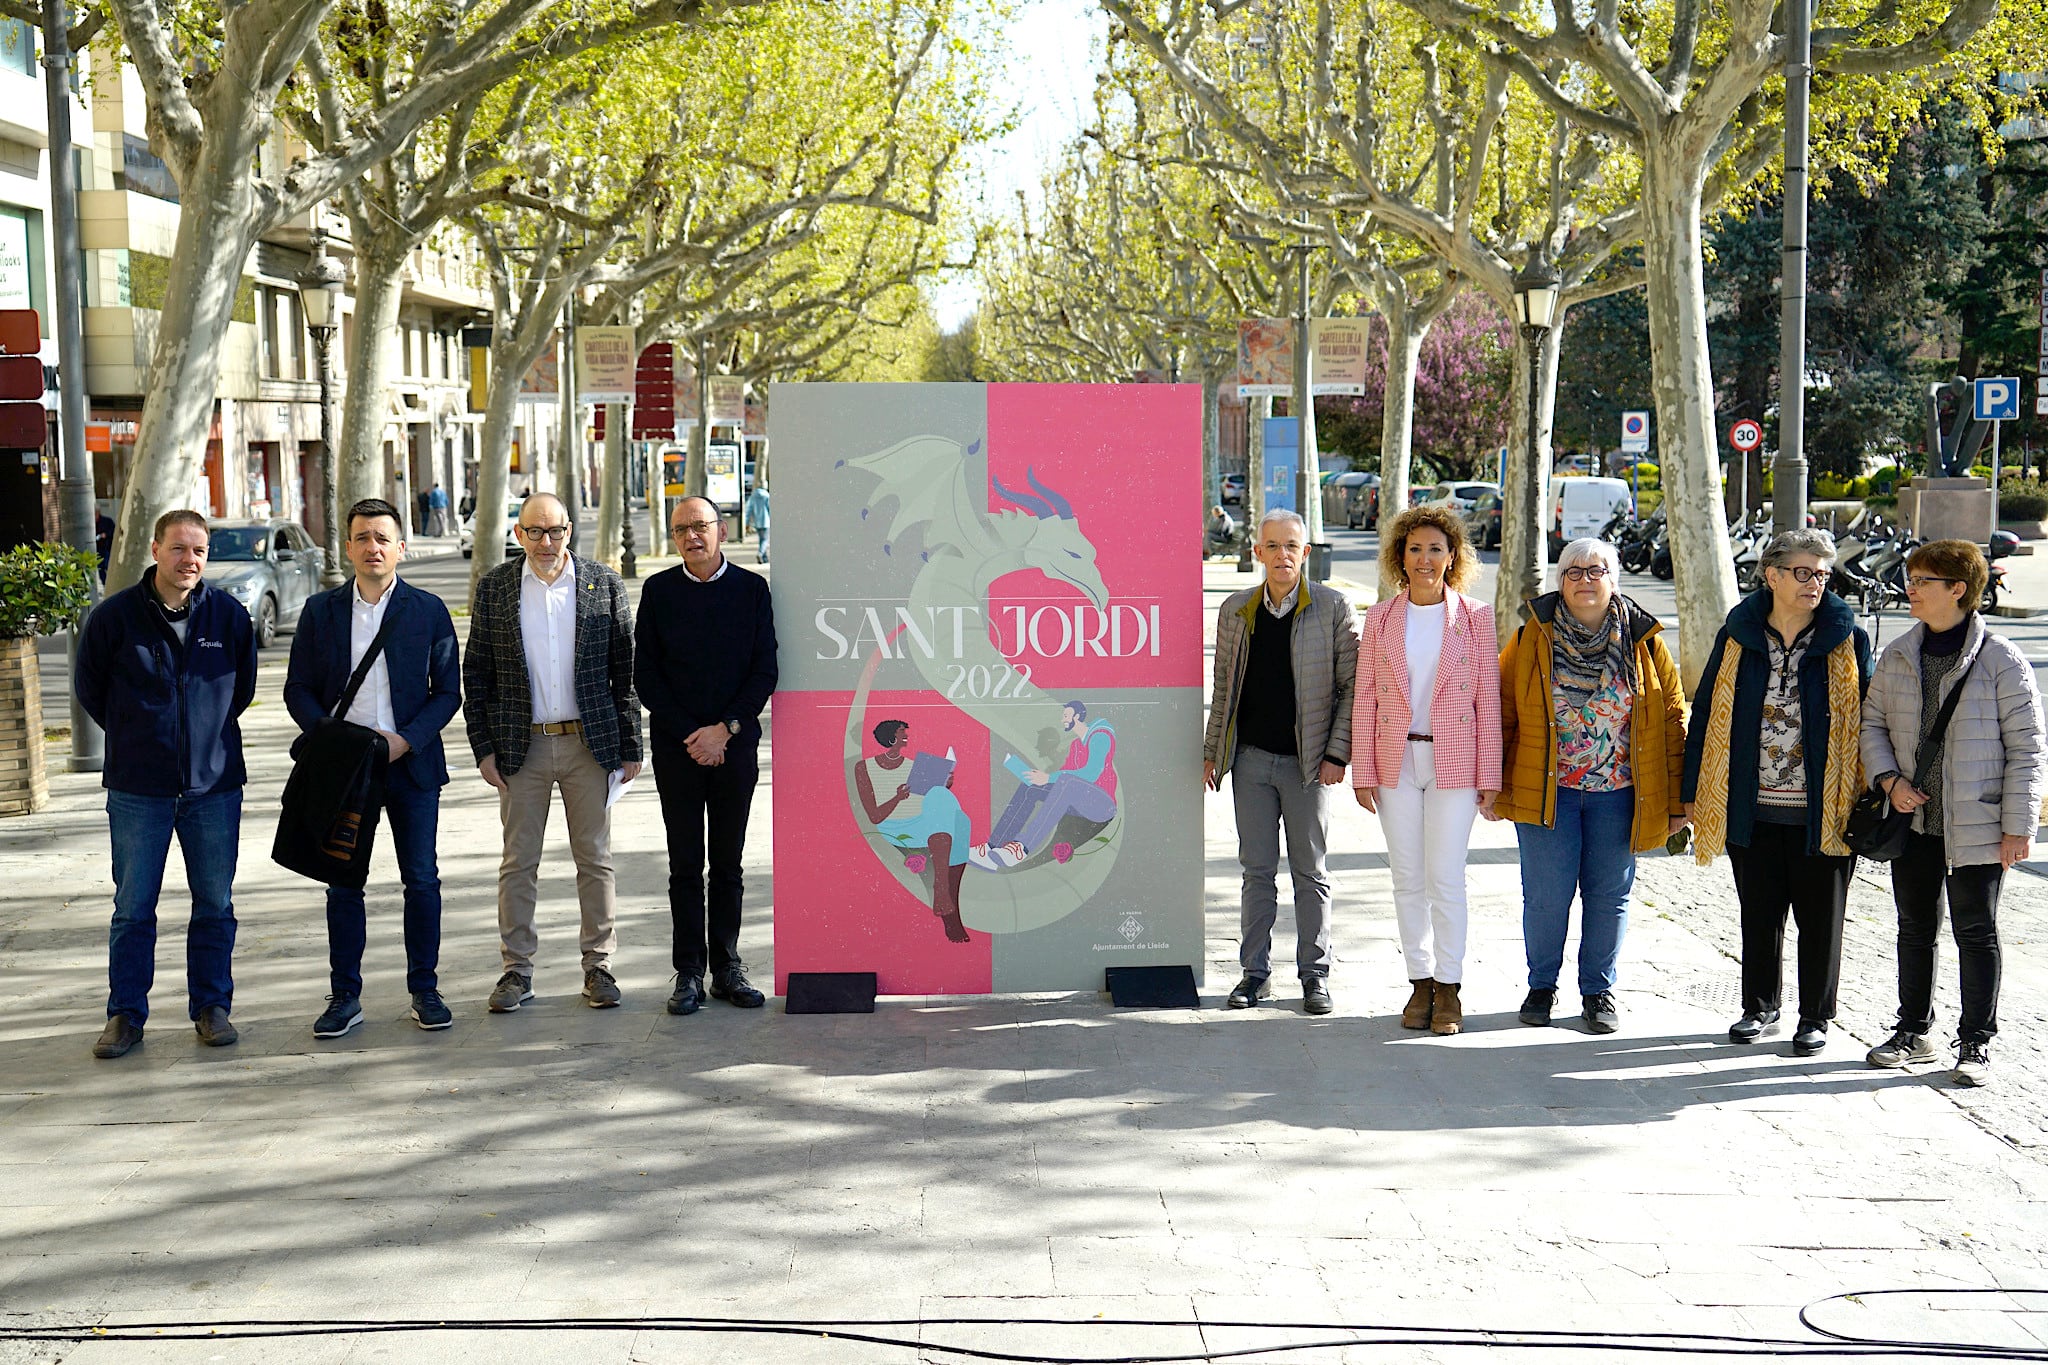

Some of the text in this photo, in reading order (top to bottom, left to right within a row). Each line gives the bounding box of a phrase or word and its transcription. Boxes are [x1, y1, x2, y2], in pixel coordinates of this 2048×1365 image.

[1983, 382, 2009, 416] P
[1737, 430, 1756, 442] 30
[814, 604, 1161, 660] SANT JORDI
[200, 640, 223, 649] aqualia
[945, 663, 1033, 699] 2022
[1092, 941, 1170, 952] Ajuntament de Lleida
